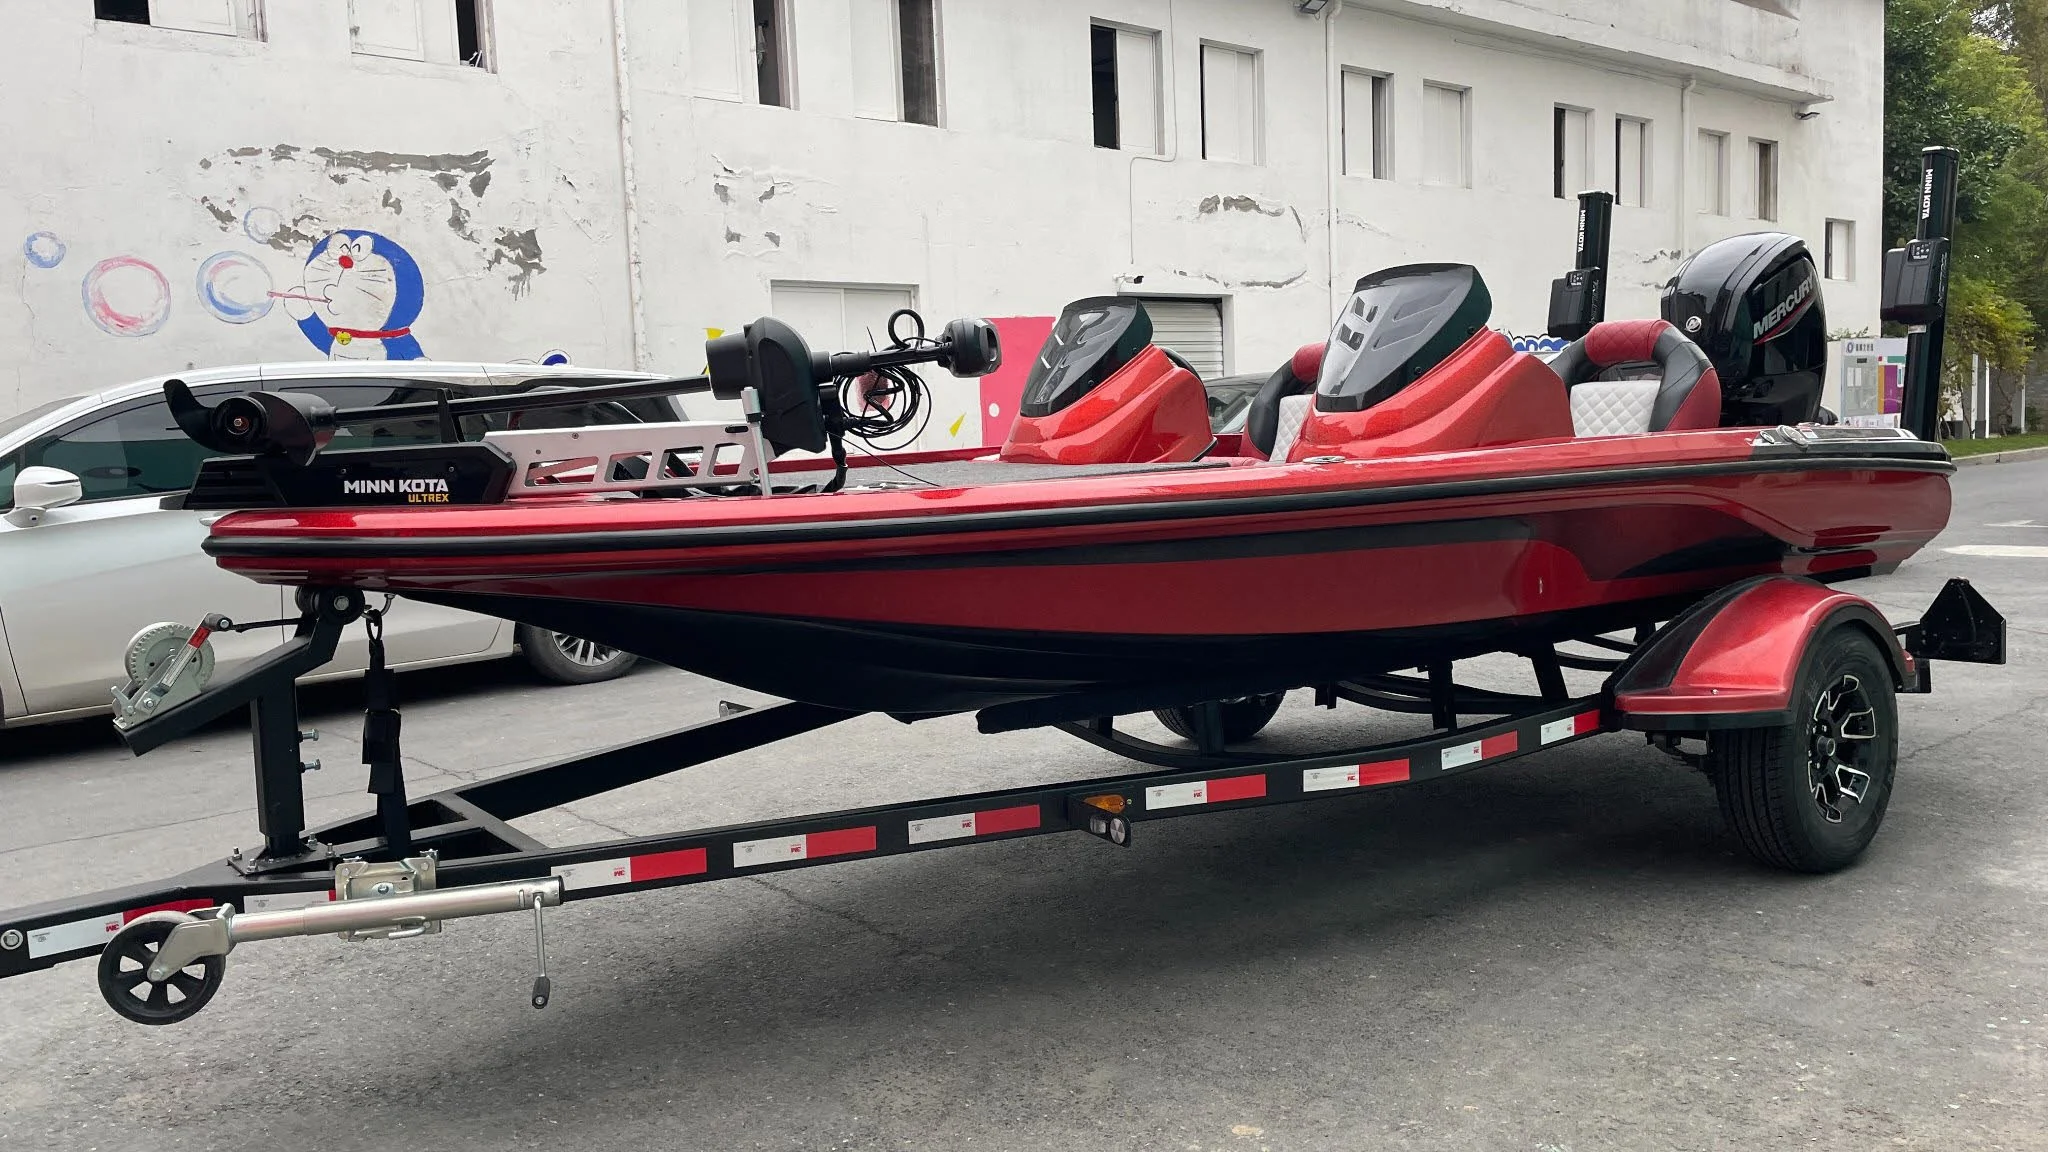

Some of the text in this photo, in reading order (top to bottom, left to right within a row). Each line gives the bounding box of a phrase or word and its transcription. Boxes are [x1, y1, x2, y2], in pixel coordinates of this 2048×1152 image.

[1921, 169, 1933, 219] MINN KOTA
[1753, 273, 1813, 339] MERCURY
[343, 478, 449, 493] MINN KOTA
[408, 493, 449, 503] ULTREX
[106, 924, 119, 932] 3M
